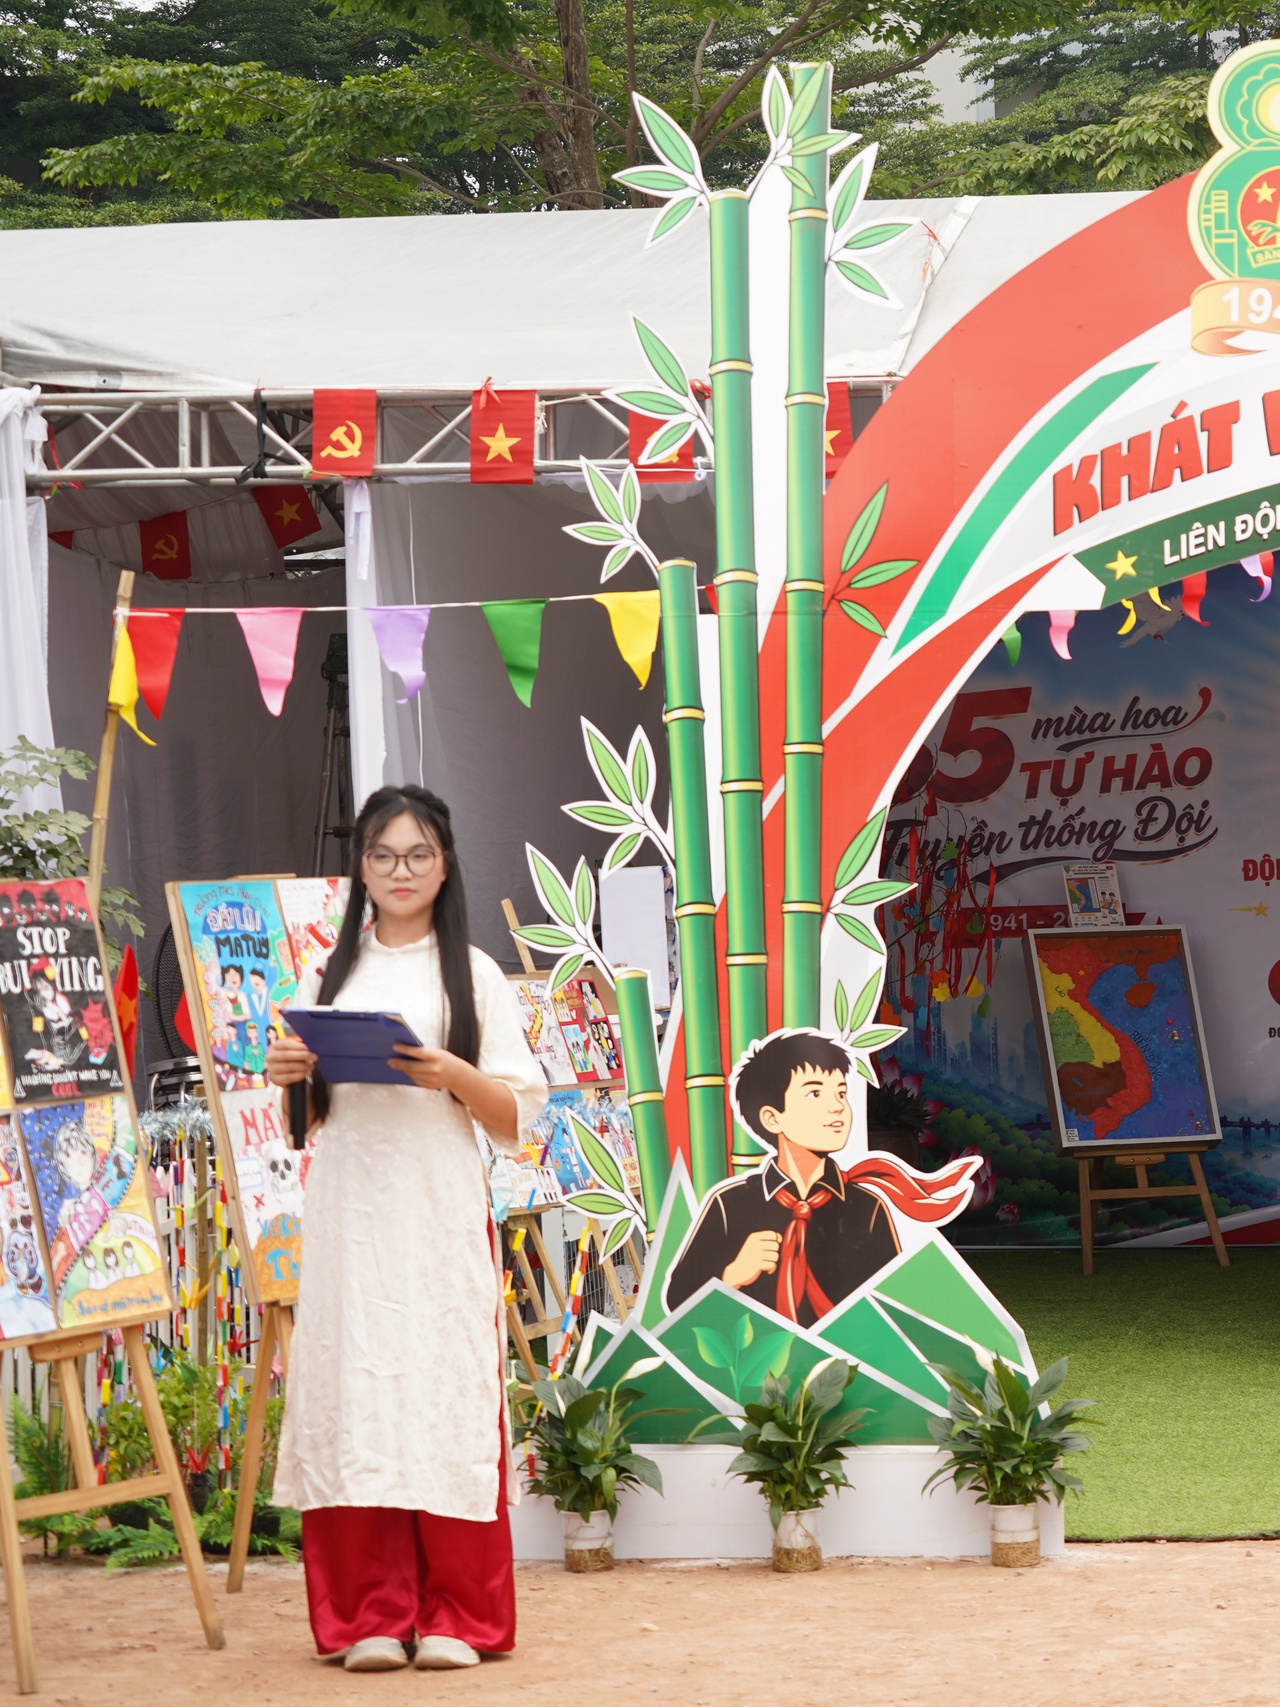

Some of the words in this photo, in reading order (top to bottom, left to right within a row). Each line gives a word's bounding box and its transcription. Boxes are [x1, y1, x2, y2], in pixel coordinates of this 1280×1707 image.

[1052, 400, 1240, 536] KHÁT
[1162, 519, 1227, 567] LIÊN
[886, 686, 1033, 806] 5
[1030, 704, 1116, 741] mùa
[1119, 695, 1192, 733] hoa
[1018, 750, 1096, 808] TỰ
[1099, 743, 1213, 798] HÀO
[1018, 804, 1126, 865] thống
[1134, 796, 1218, 850] Đội
[16, 926, 70, 956] STOP
[983, 912, 1028, 931] 941
[0, 956, 104, 994] BULYING
